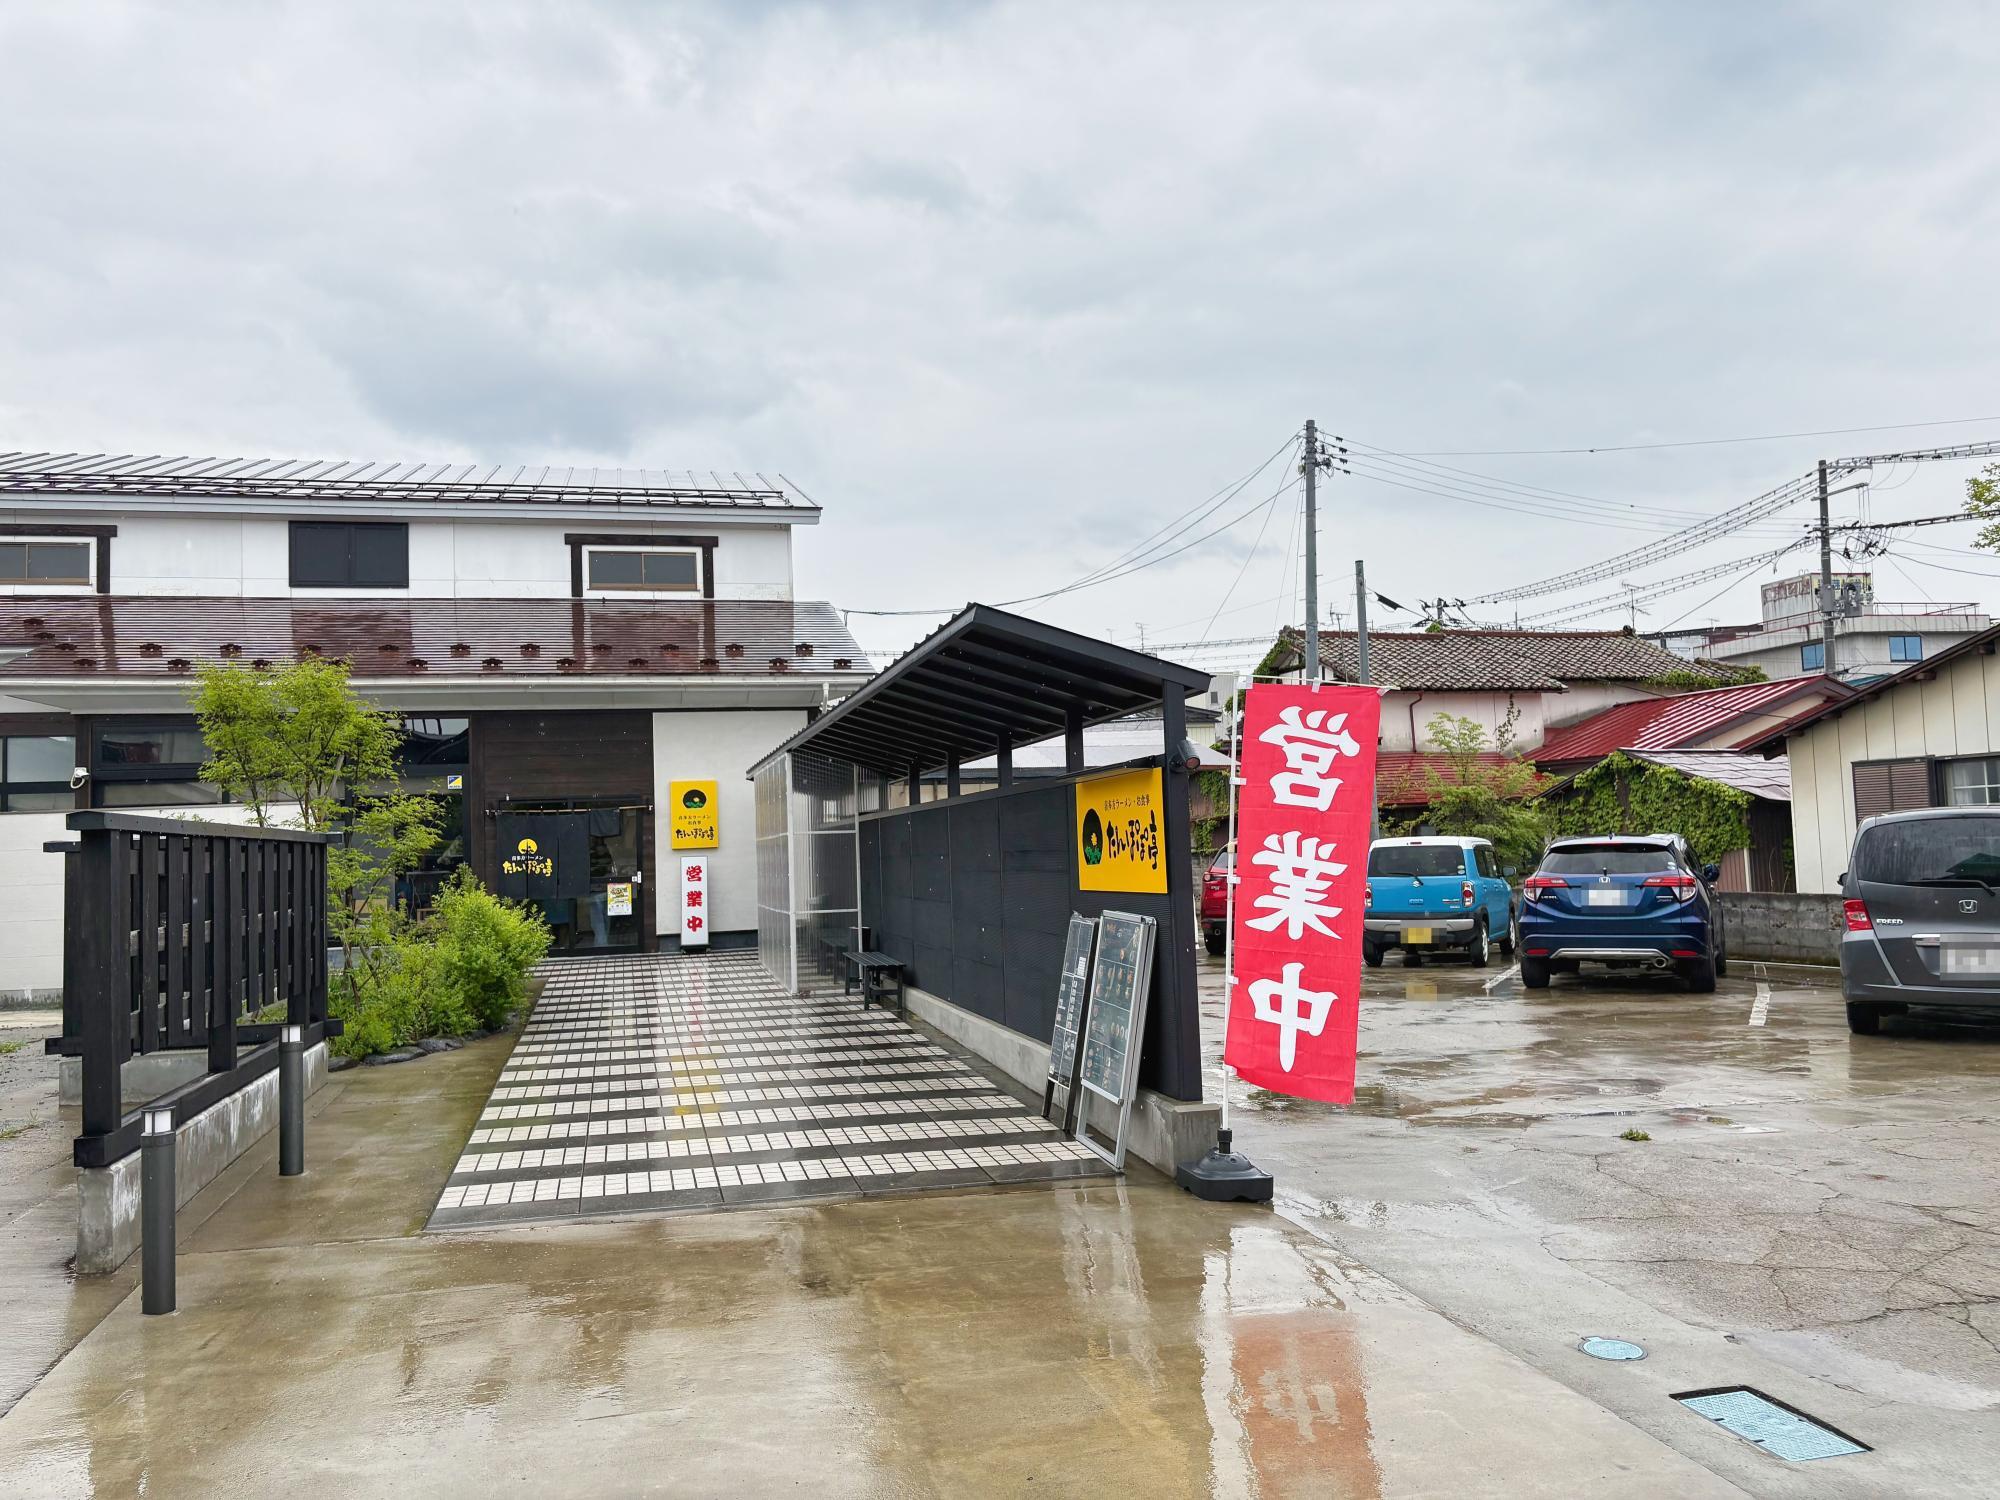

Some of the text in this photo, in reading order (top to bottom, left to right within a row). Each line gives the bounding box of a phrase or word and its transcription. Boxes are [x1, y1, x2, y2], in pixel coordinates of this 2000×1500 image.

[675, 826, 715, 841] たんぽぽ亭
[1106, 809, 1159, 870] たんぽぽ亭
[502, 858, 553, 877] たんぽぽ亭
[1245, 705, 1360, 1073] 営業中
[686, 865, 704, 932] 営業中
